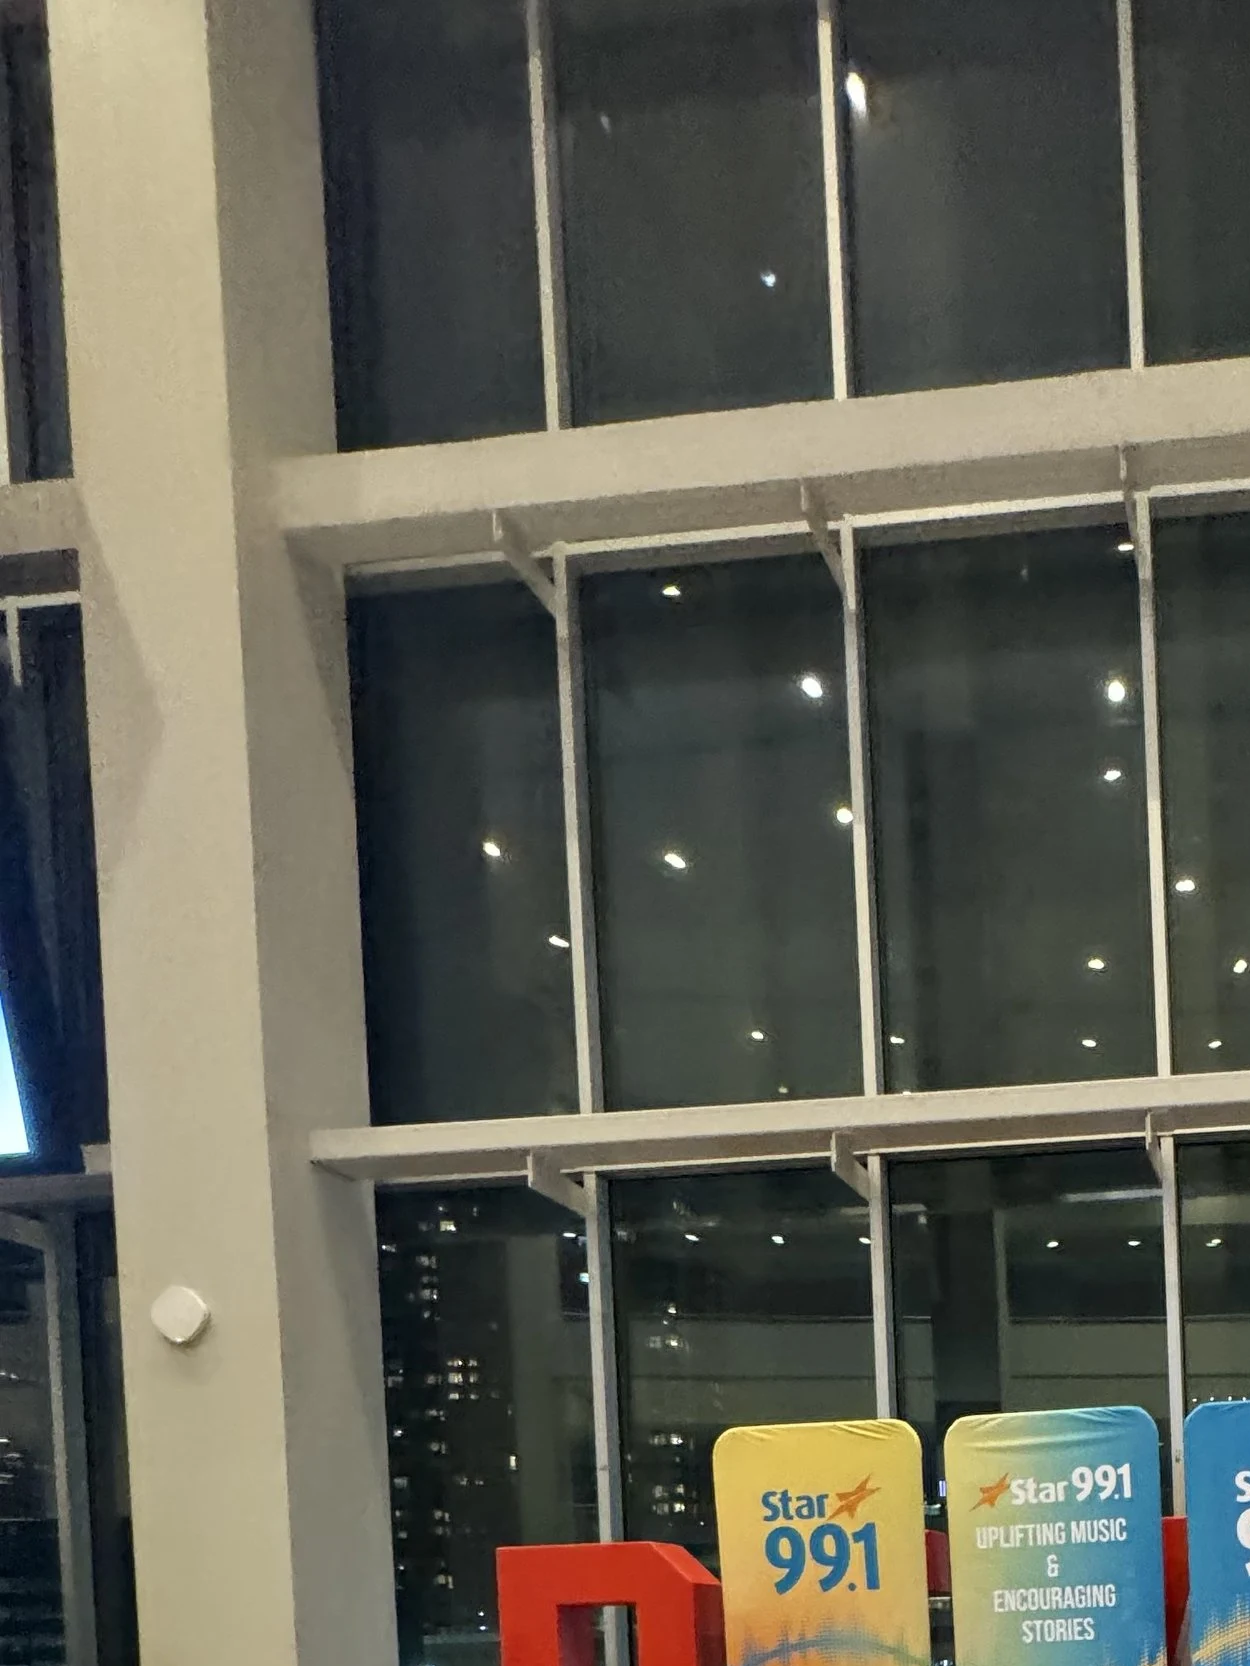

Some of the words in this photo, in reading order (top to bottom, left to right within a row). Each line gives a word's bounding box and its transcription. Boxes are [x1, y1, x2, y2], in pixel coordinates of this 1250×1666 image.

[1010, 1476, 1070, 1505] Star
[1072, 1462, 1133, 1501] 99.1
[761, 1488, 830, 1522] Star
[975, 1521, 1066, 1550] UPLIFTING
[1070, 1517, 1128, 1545] MUSIC
[765, 1522, 881, 1596] 99.1
[1046, 1554, 1060, 1578] &
[993, 1583, 1117, 1613] ENCOURAGING
[1022, 1617, 1096, 1644] STORIES
